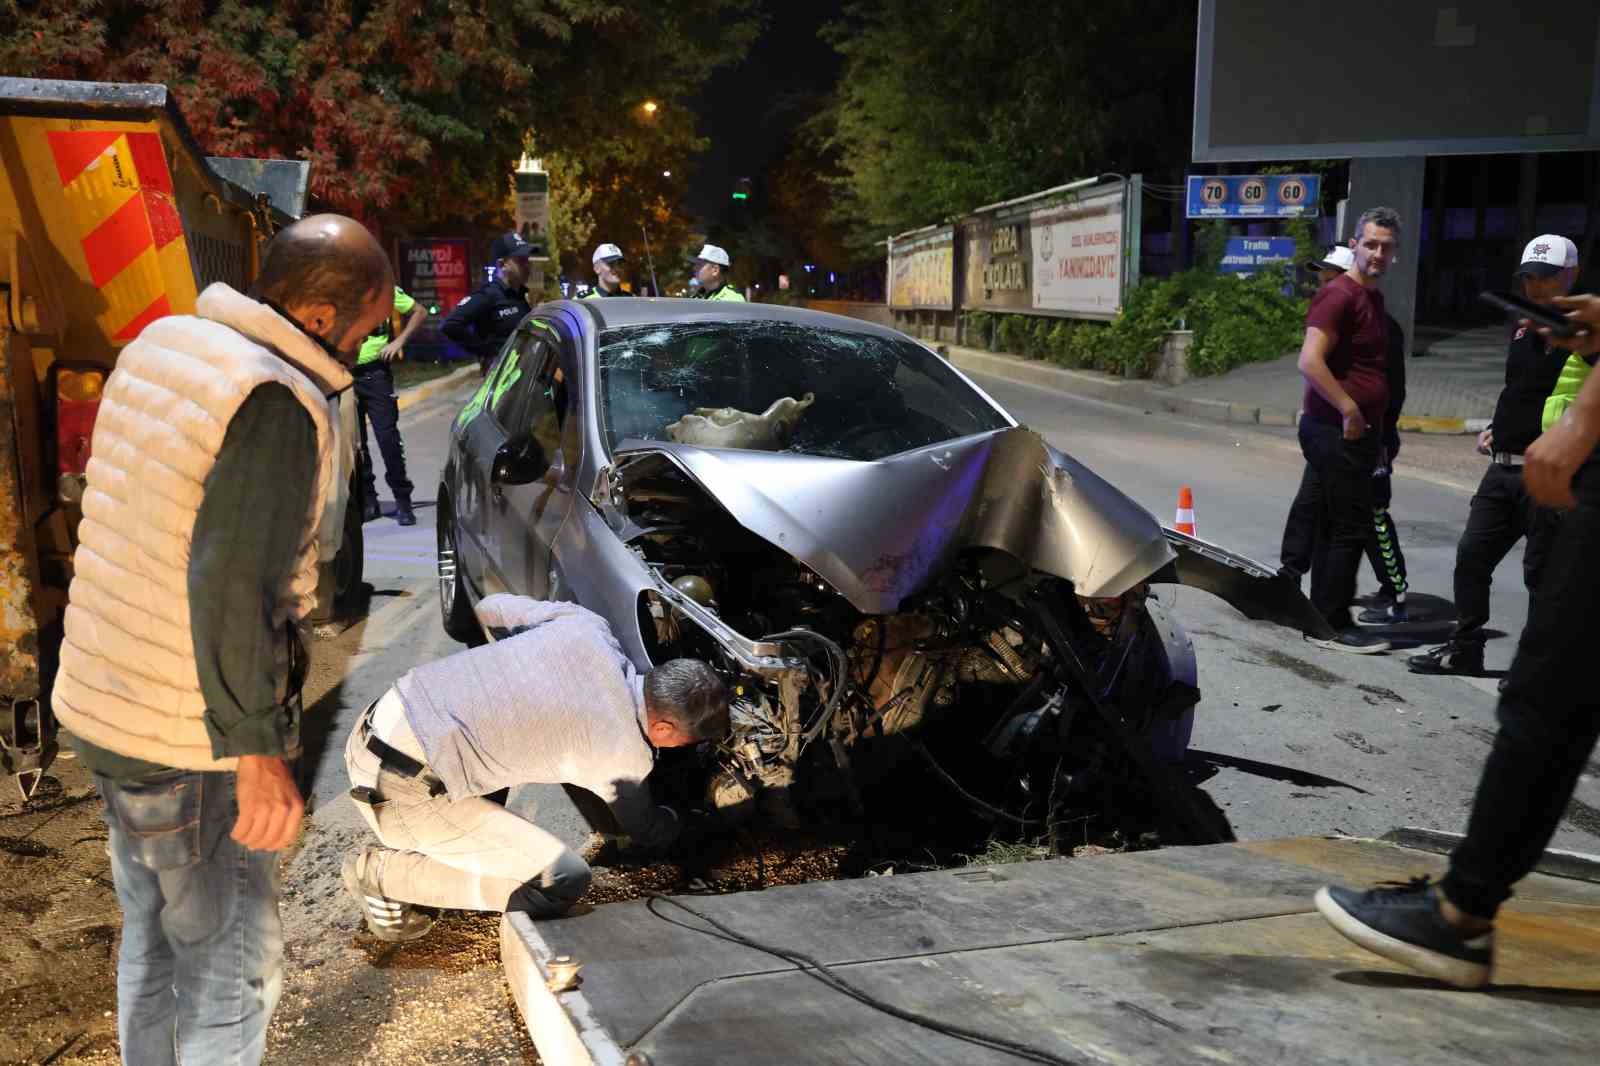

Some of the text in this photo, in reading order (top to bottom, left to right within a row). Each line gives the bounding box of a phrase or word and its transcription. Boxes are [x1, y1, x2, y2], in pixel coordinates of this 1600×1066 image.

[1206, 186, 1222, 200] 70
[1245, 186, 1261, 200] 60
[1283, 185, 1301, 200] 60
[1243, 239, 1270, 251] Trafik
